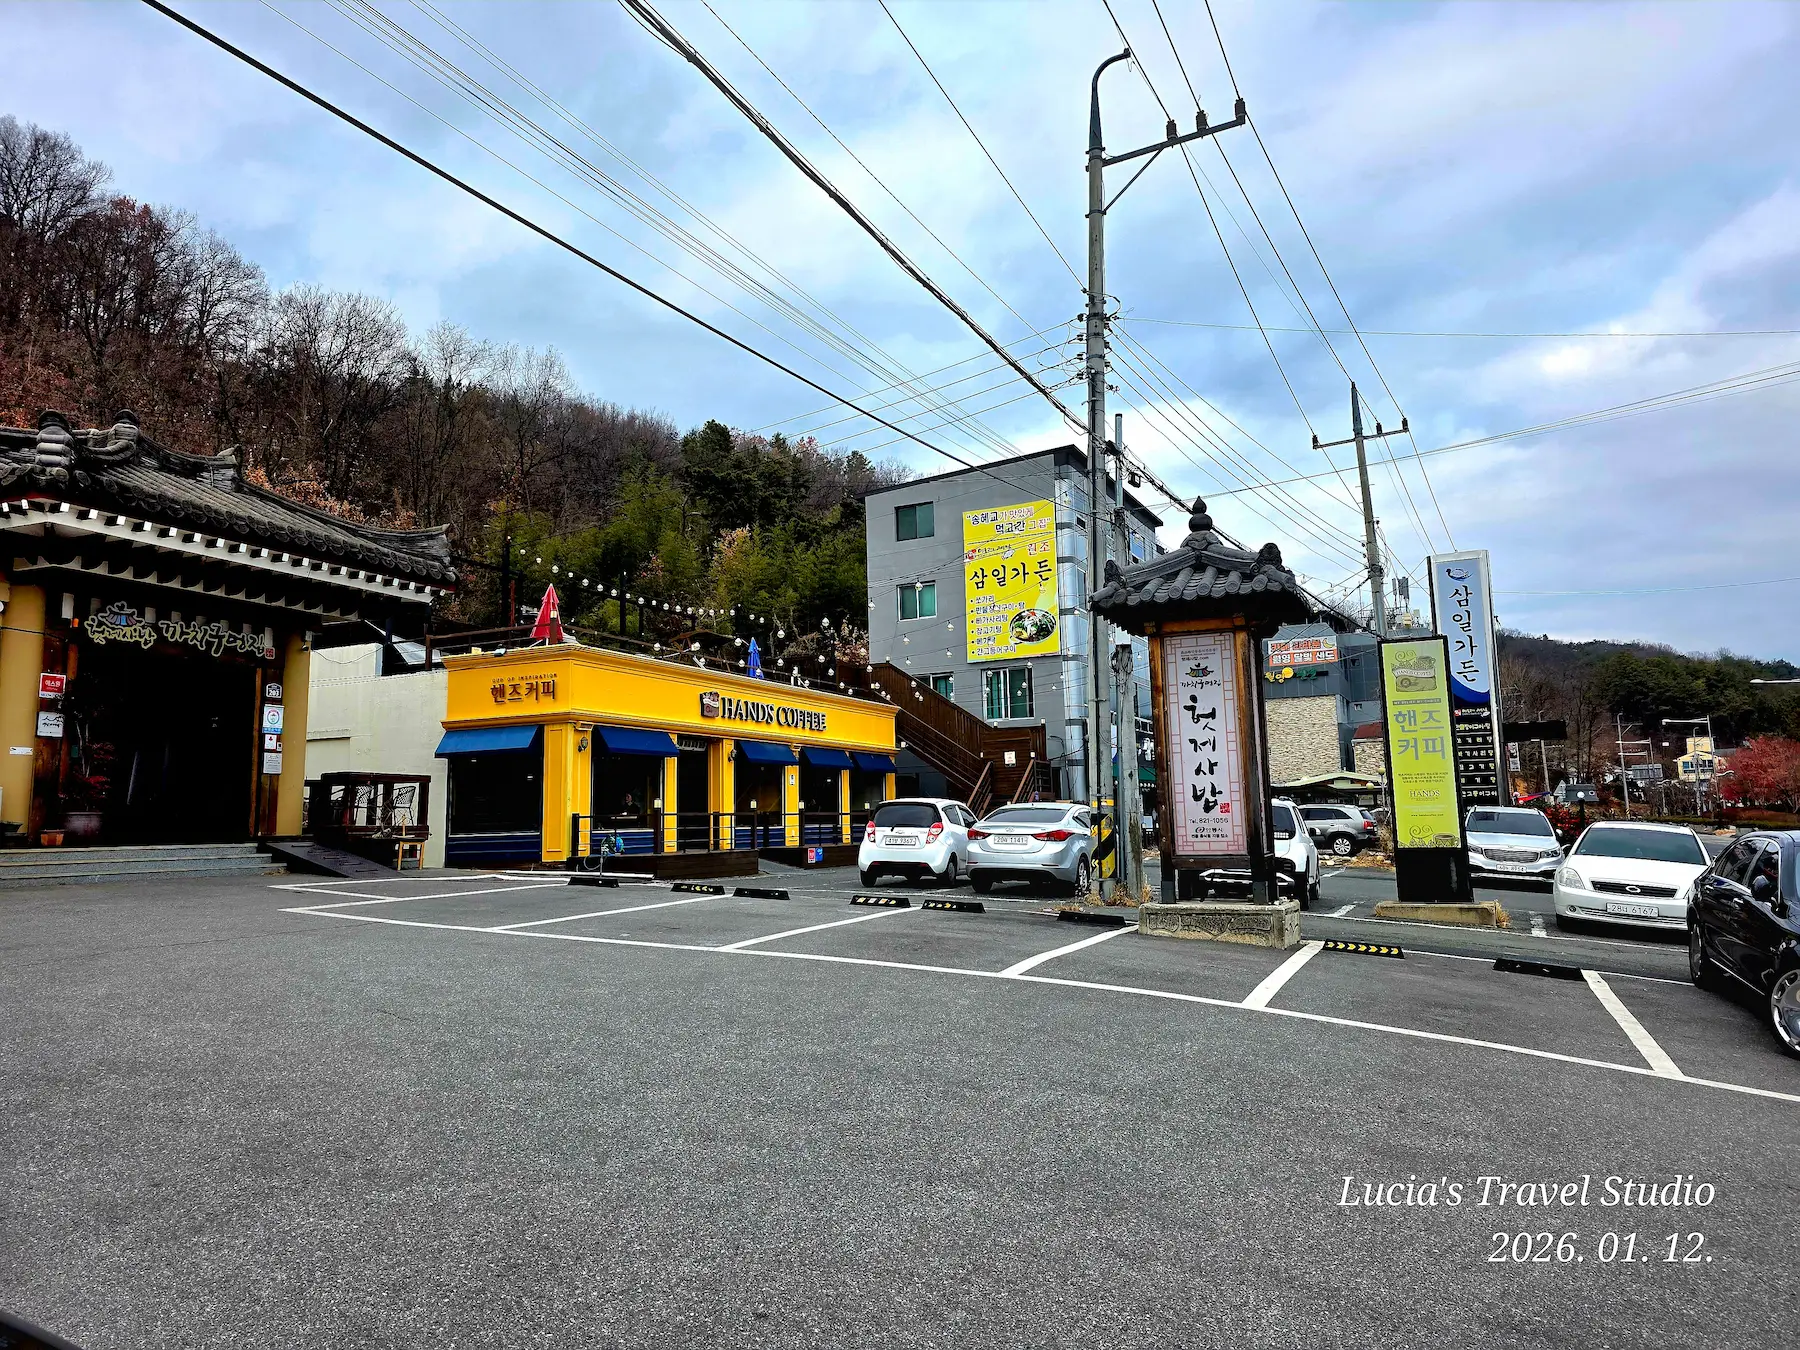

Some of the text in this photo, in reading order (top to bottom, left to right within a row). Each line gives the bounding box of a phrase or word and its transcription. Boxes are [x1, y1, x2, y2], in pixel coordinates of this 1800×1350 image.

[969, 559, 1053, 589] 삼일가든
[1449, 584, 1480, 682] 삼일가든
[490, 679, 556, 703] 핸즈커피
[721, 696, 827, 731] HANDS COFFEE
[1393, 709, 1444, 733] 핸즈
[1397, 736, 1446, 760] 커피
[1409, 789, 1440, 797] HANDS
[1631, 906, 1654, 915] 6167
